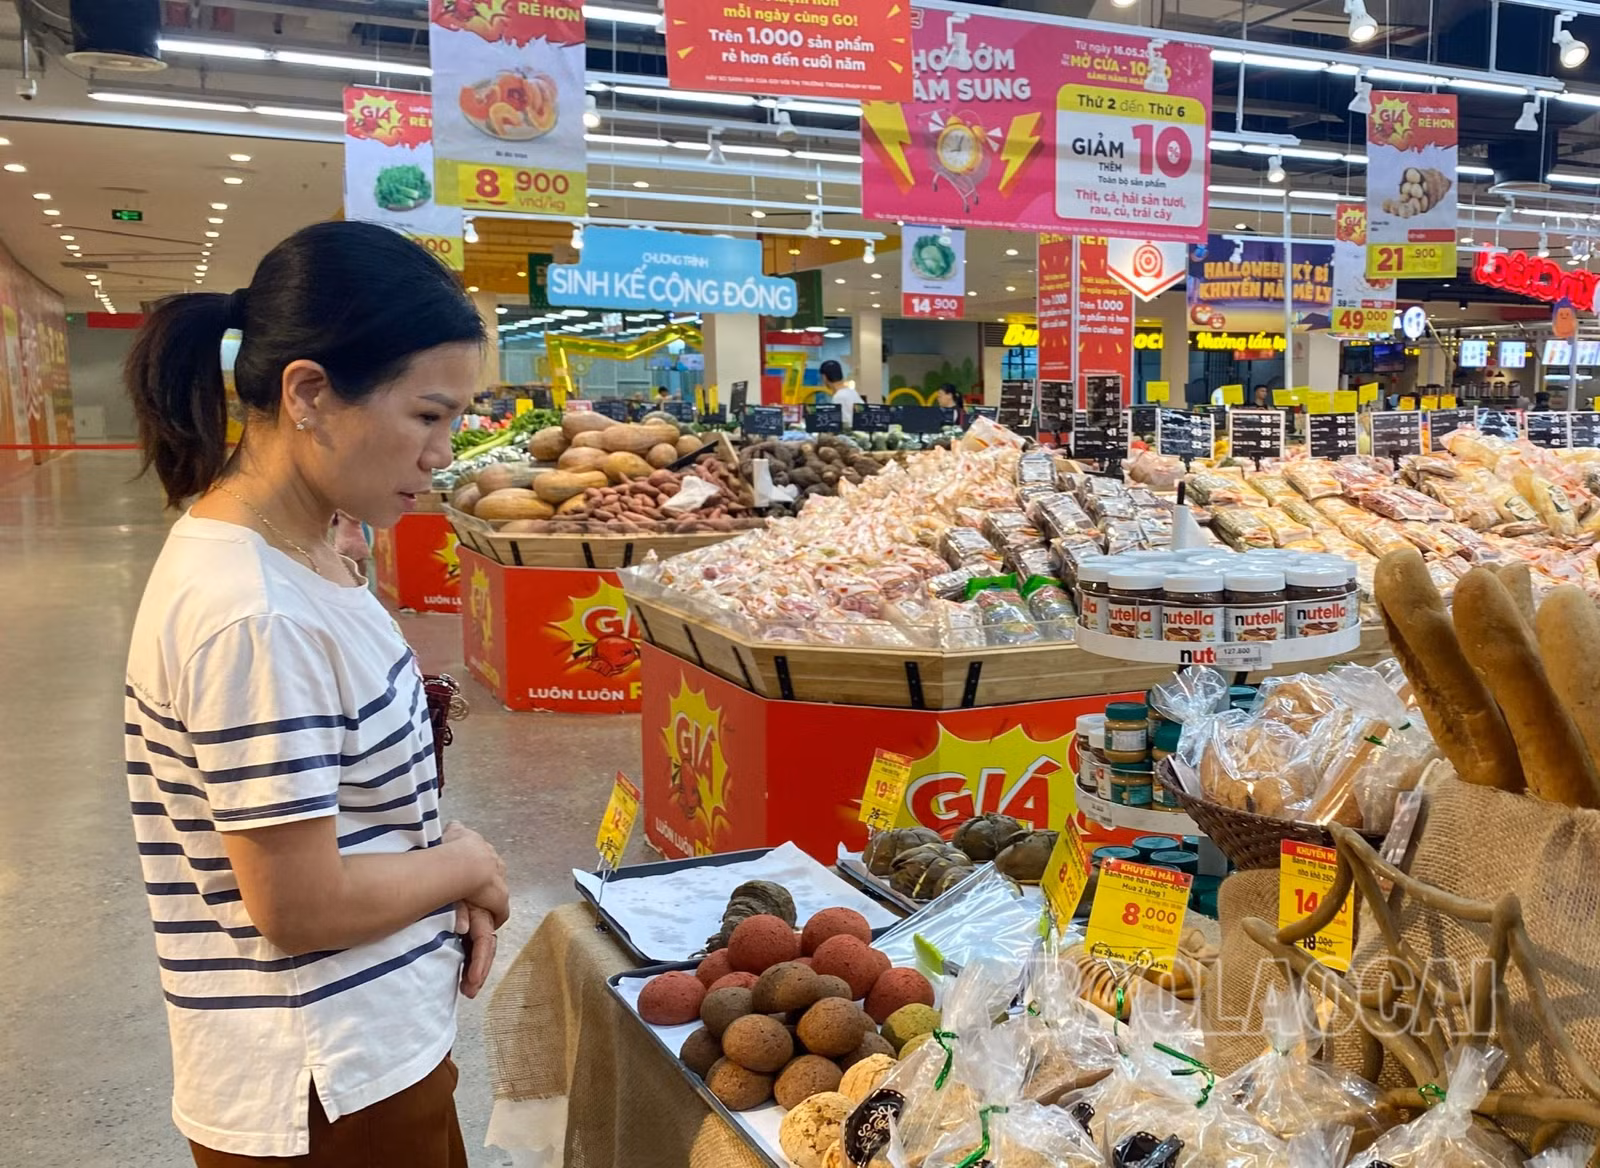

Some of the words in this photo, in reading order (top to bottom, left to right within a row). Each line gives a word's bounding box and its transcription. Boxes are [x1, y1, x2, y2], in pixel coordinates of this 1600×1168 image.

[543, 6, 580, 22] HƠN
[723, 5, 751, 19] mỗi
[755, 9, 790, 25] ngày
[794, 11, 829, 26] cùng
[832, 13, 858, 27] GO!
[708, 28, 743, 44] Trên
[746, 27, 803, 47] 1.000
[807, 35, 833, 49] sản
[835, 36, 875, 53] phẩm
[722, 50, 738, 63] rẻ
[740, 50, 769, 65] hơn
[772, 52, 799, 67] đến
[802, 53, 832, 69] cuối
[835, 56, 866, 71] năm
[912, 46, 949, 76] HỢ
[971, 42, 1016, 71] ỚM
[1071, 52, 1091, 68] MỞ
[913, 71, 951, 101] ẢM
[957, 77, 1032, 101] SUNG
[360, 106, 391, 123] GIÁ
[1077, 94, 1104, 107] Thứ
[1107, 99, 1116, 109] 2
[1120, 99, 1144, 113] đến
[1148, 102, 1173, 116] Thứ
[1177, 106, 1185, 117] 6
[1380, 108, 1406, 128] GIÁ
[1072, 132, 1124, 158] GIẢM
[1131, 124, 1192, 178] 10
[1098, 161, 1122, 172] THÊM
[475, 169, 500, 199] 8
[1076, 189, 1101, 204] Thịt,
[1104, 191, 1119, 204] cá,
[1142, 193, 1160, 206] sản
[1090, 206, 1111, 217] rau,
[1133, 207, 1151, 218] trái
[1154, 208, 1172, 221] cây
[1378, 247, 1403, 271] 21
[1204, 261, 1285, 280] HALLOWEE
[552, 268, 609, 297] SINH
[614, 263, 649, 299] KẾ
[649, 271, 718, 307] CỘNG
[722, 276, 792, 310] ĐỒNG
[1097, 299, 1124, 311] 1.000
[1003, 323, 1040, 346] Bu
[424, 595, 450, 605] LUÔN
[1163, 607, 1214, 625] nutella
[1297, 603, 1346, 621] nutella
[1180, 646, 1217, 664] nut
[529, 686, 573, 700] LUÔN
[578, 686, 624, 701] LUÔN
[675, 711, 717, 799] GIÁ
[906, 754, 1062, 834] GIÁ
[656, 816, 674, 844] LUÔN
[1296, 846, 1326, 860] KHUYẾN
[1121, 862, 1157, 878] KHUYẾN
[1122, 882, 1137, 892] Mua
[1295, 888, 1318, 914] 14
